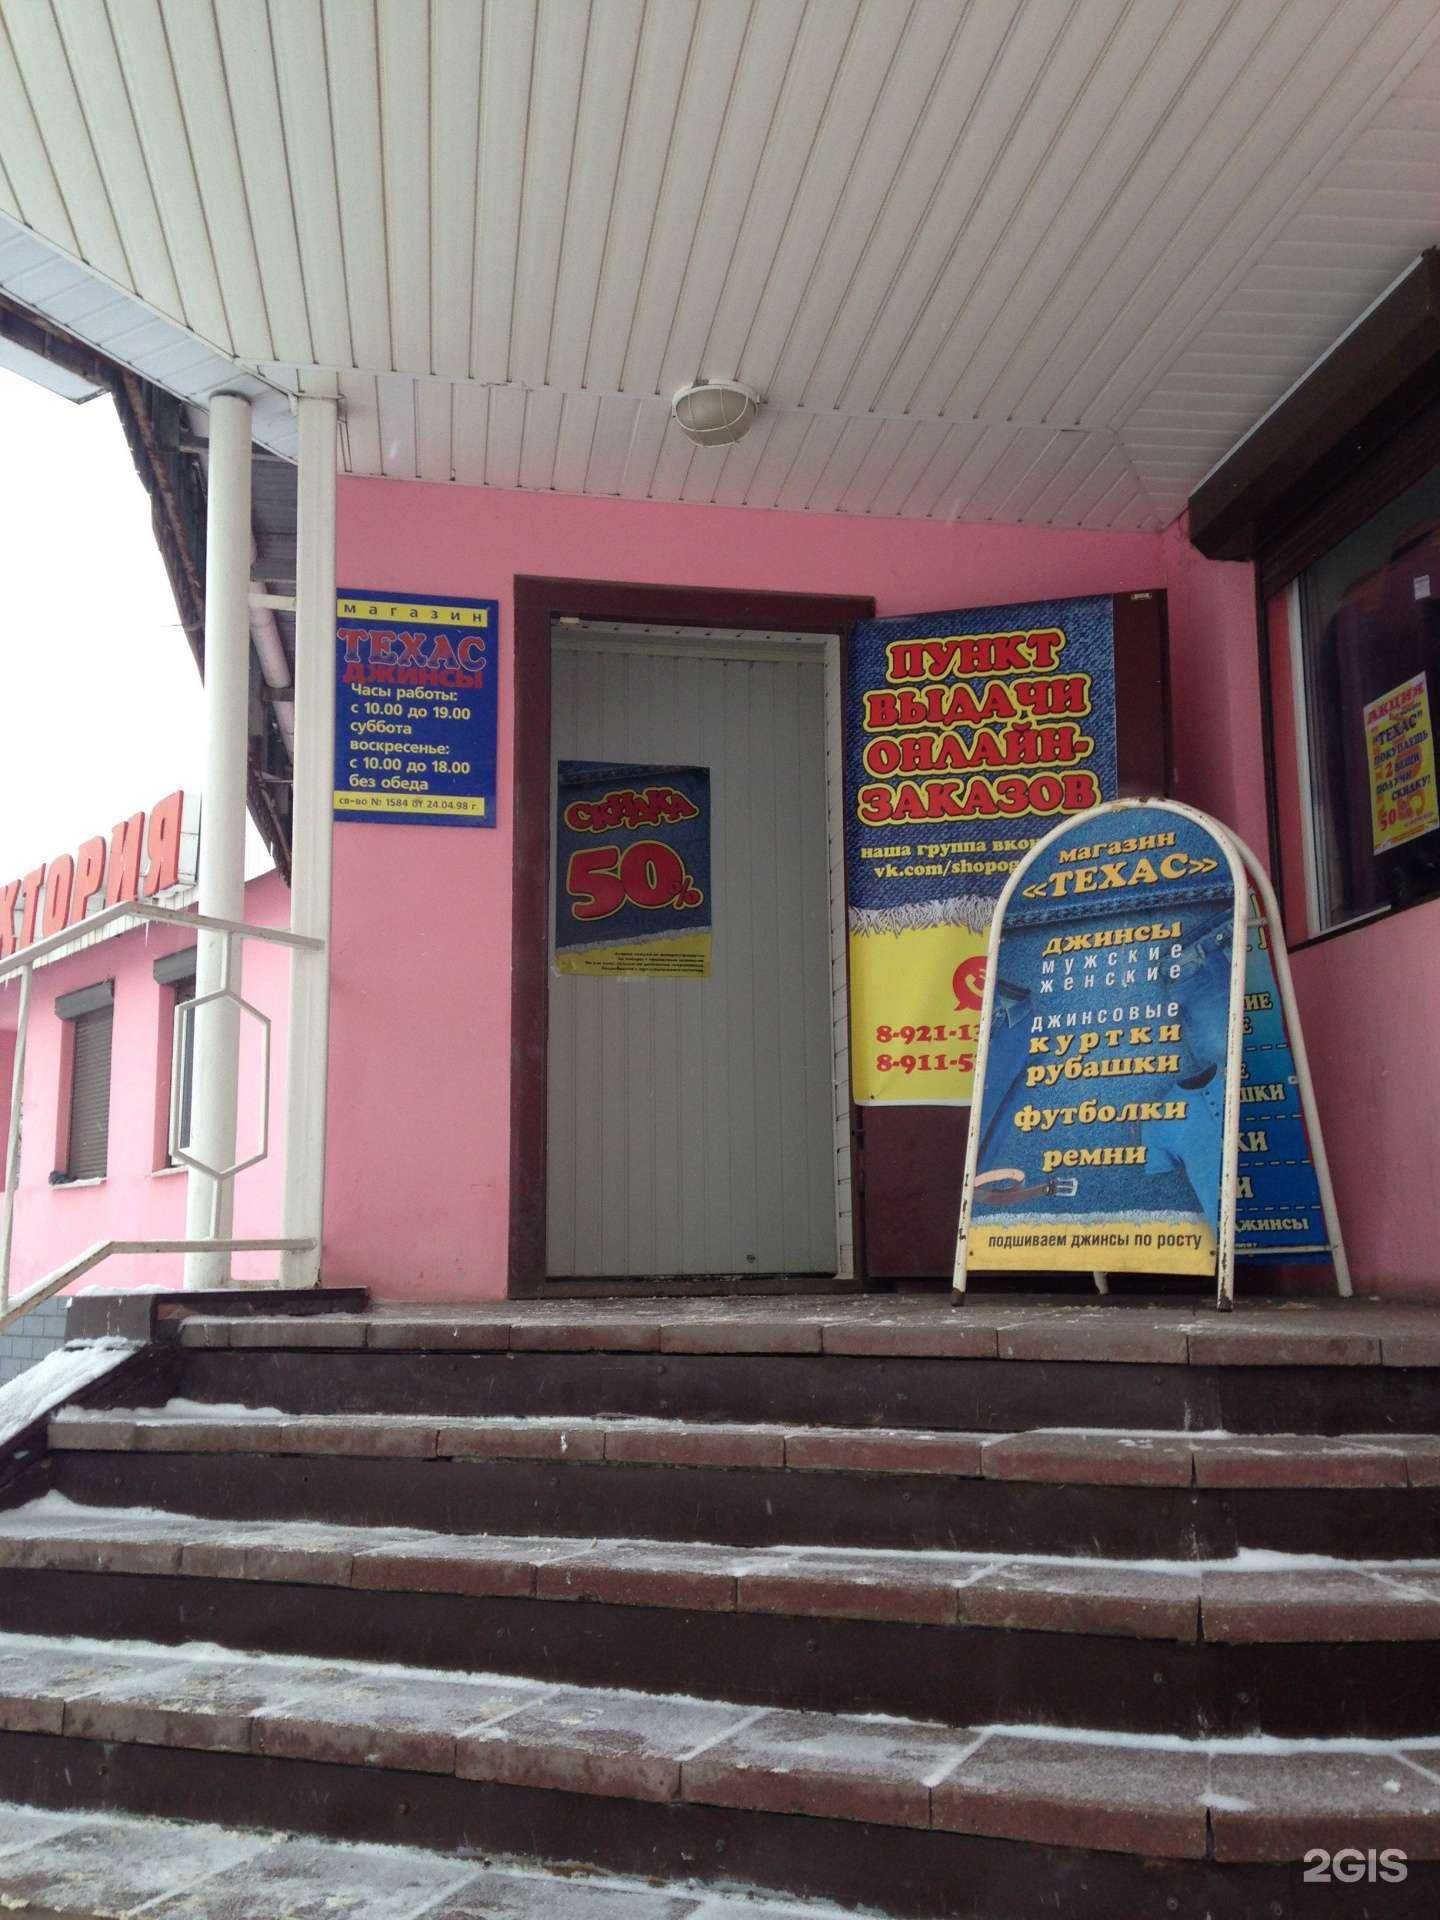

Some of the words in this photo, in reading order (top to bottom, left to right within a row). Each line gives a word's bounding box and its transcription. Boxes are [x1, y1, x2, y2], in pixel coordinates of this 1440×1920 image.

[344, 604, 482, 622] магазин
[337, 627, 487, 671] ТЕХАС
[887, 630, 1065, 681] ПУНКТ
[343, 663, 483, 688] ДЖИНСЫ
[351, 683, 391, 698] Часы
[397, 685, 458, 701] работы:
[865, 675, 1090, 729] ВЫДАЧИ
[350, 703, 358, 714] с
[364, 703, 403, 716] 10.00
[407, 707, 428, 719] до
[433, 706, 471, 720] 19.00
[350, 720, 412, 735] суббота
[350, 740, 450, 755] воскресенье:
[865, 719, 1093, 776] ОНЛАЙН-
[349, 758, 357, 768] с
[363, 757, 402, 771] 10.00
[406, 761, 427, 774] до
[431, 760, 470, 774] 18.00
[349, 774, 376, 788] без
[381, 776, 429, 791] обеда
[859, 771, 1099, 824] ЗАКАЗОВ
[386, 797, 408, 808] 1584
[564, 787, 699, 833] СКИДКА
[860, 845, 911, 858] наша
[916, 841, 987, 858] группа
[1058, 832, 1175, 864] магазин
[566, 840, 704, 921] 50%
[1042, 921, 1183, 957] джинсы
[1042, 943, 1182, 975] мужские
[1040, 964, 1181, 994] женские
[1031, 1001, 1179, 1033] джинсовые
[1029, 1024, 1181, 1056] куртки
[876, 1053, 976, 1074] 8-911-5
[1026, 1054, 1180, 1086] рубашки
[1013, 1099, 1187, 1132] футболки
[1042, 1146, 1148, 1172] ремни
[988, 1234, 1067, 1249] подшиваем
[1071, 1232, 1129, 1249] джинсы
[1134, 1234, 1152, 1247] по
[1157, 1233, 1202, 1249] росту
